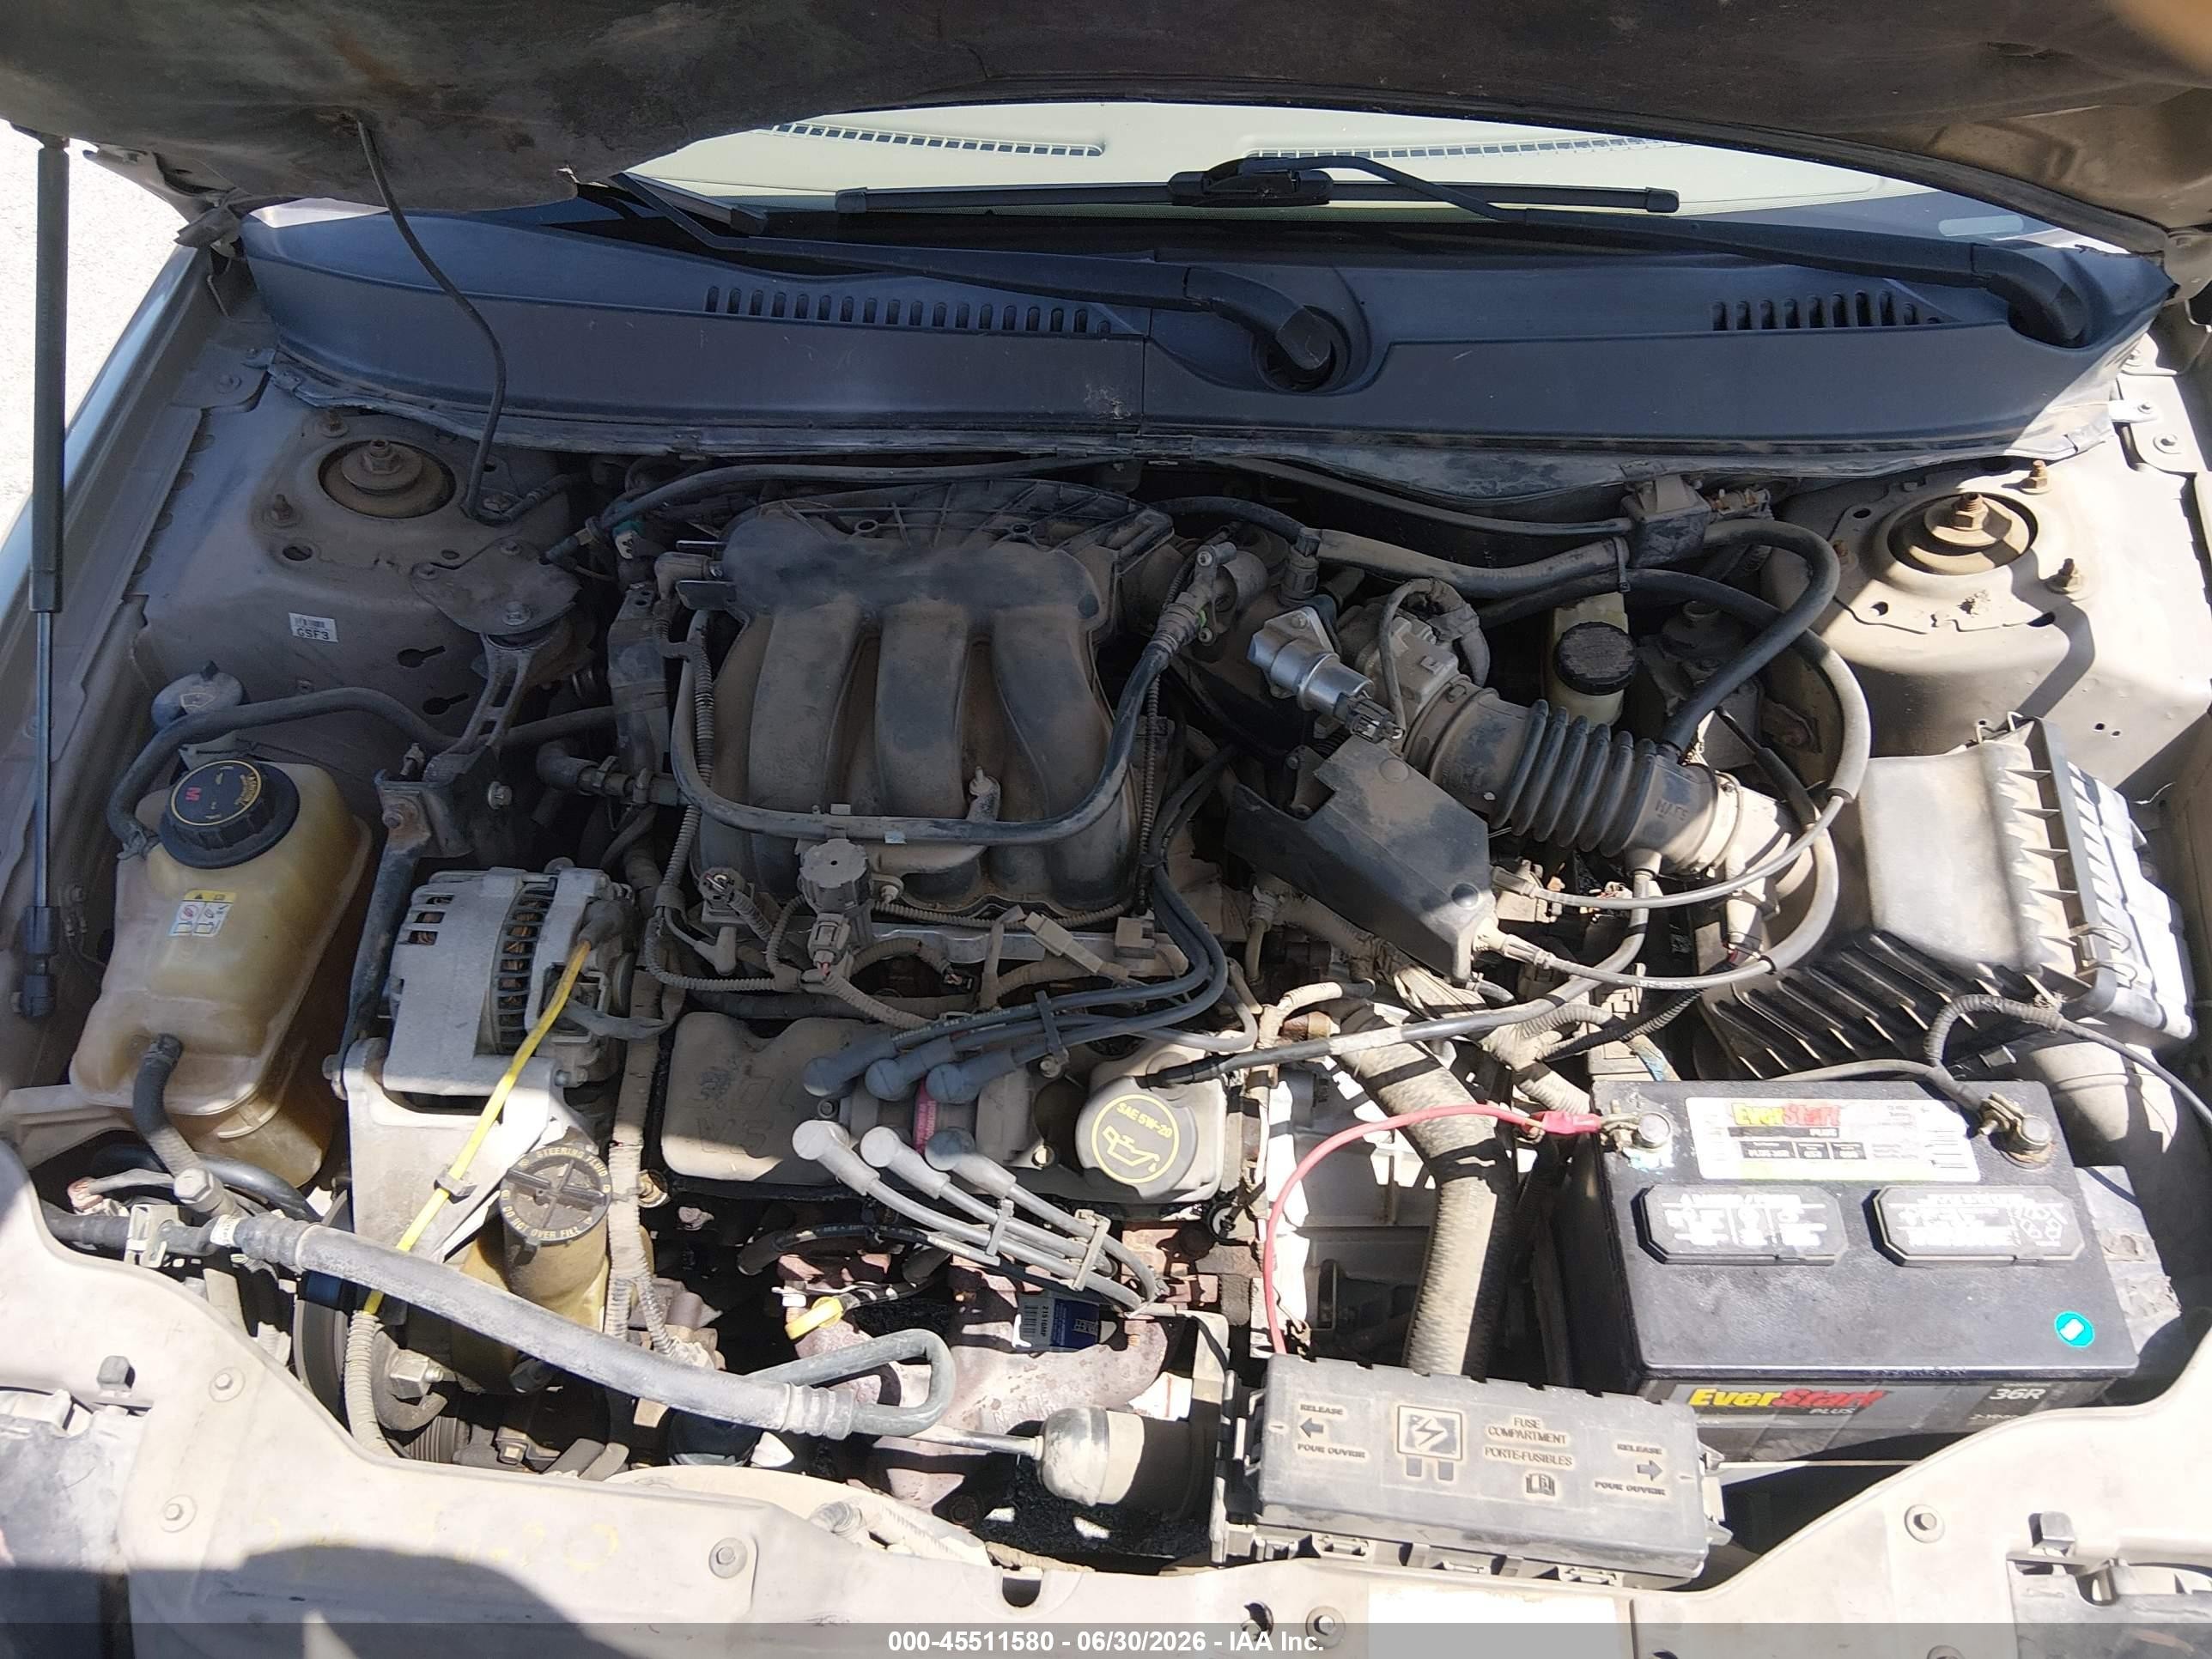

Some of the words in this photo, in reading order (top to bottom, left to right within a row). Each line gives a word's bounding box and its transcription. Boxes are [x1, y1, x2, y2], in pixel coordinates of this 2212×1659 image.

[1117, 1102, 1139, 1121] SAE
[1138, 1114, 1173, 1139] 5W-20
[1731, 1102, 1840, 1127] EverStart
[536, 1146, 585, 1158] STEERING
[584, 1155, 609, 1177] FLUID
[530, 1228, 556, 1239] OVER
[560, 1226, 581, 1238] FILL
[1688, 1387, 1888, 1408] EverStart
[1988, 1388, 2045, 1400] 36R
[1300, 1403, 1344, 1416] RELEASE
[1809, 1407, 1856, 1415] PLUS
[1513, 1416, 1541, 1430] FUSE
[1487, 1425, 1567, 1444] COMPARTMENT
[1484, 1446, 1574, 1467] PORTE-FUSIBLES
[1616, 1443, 1663, 1455] RELEASE
